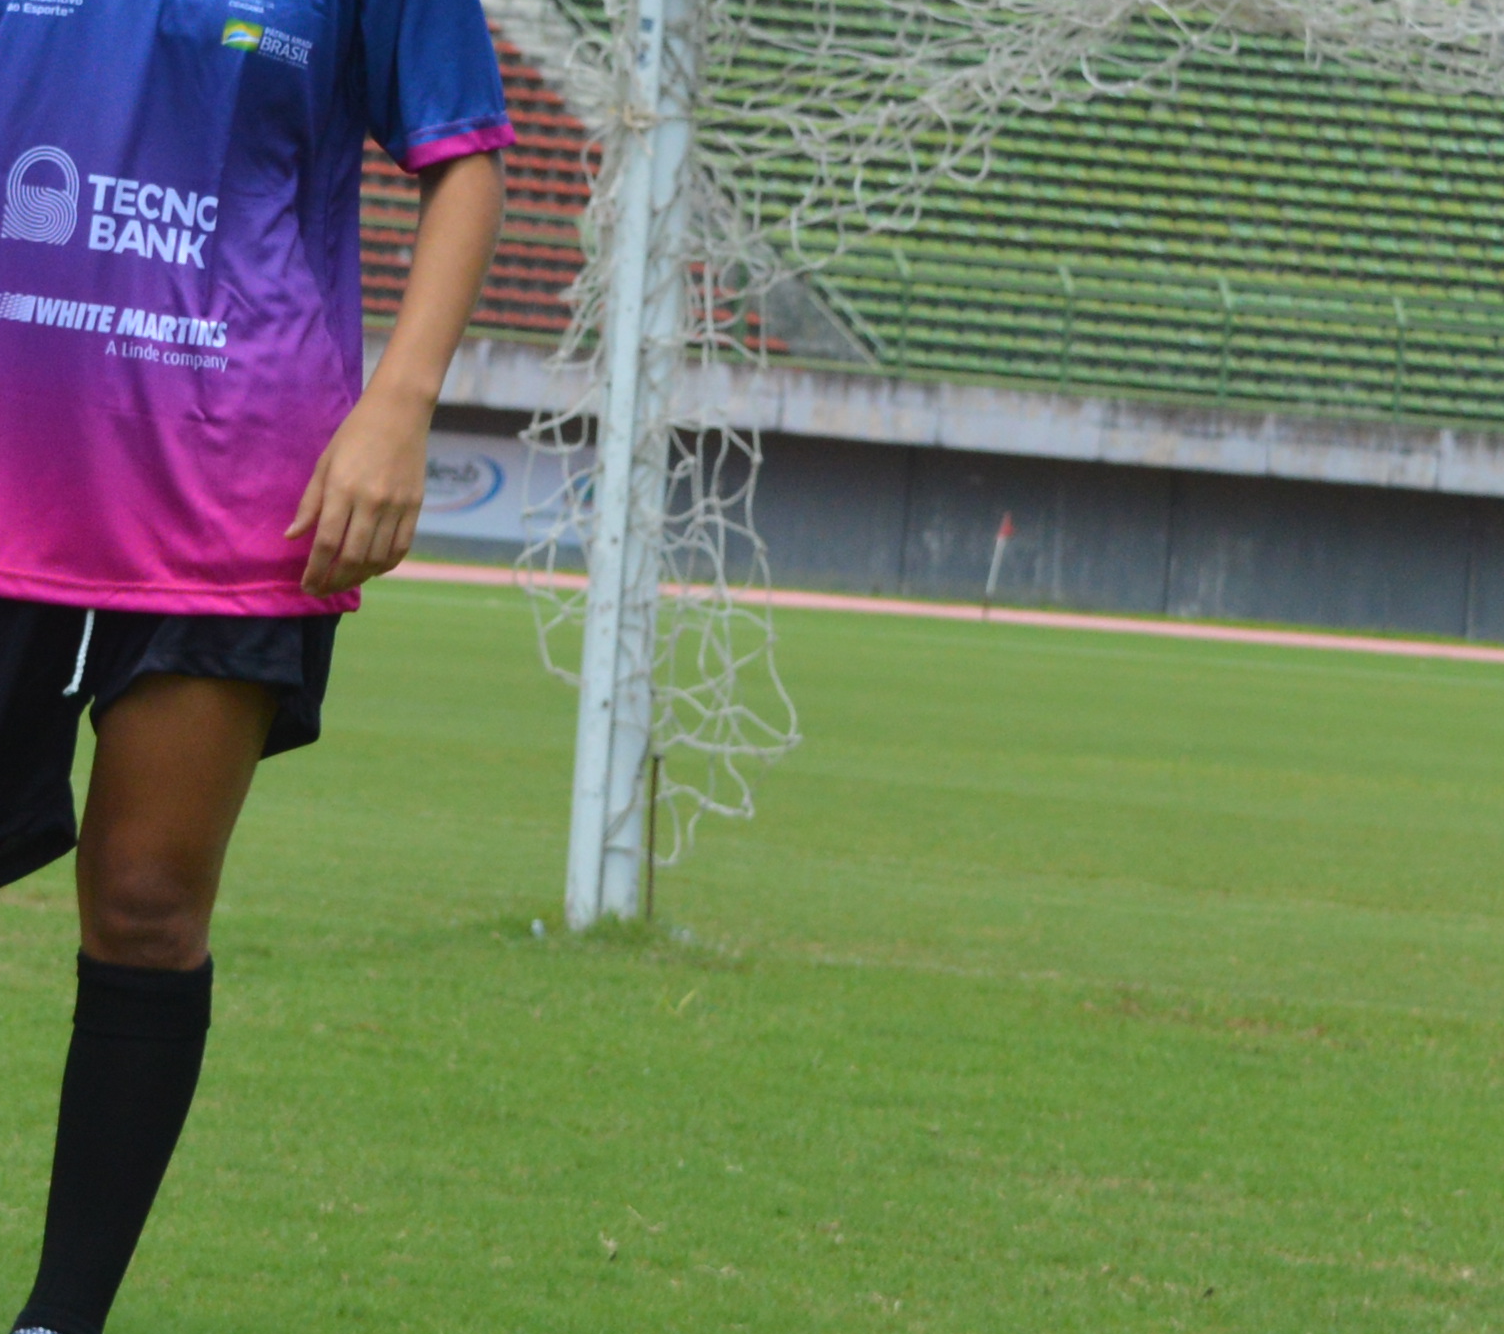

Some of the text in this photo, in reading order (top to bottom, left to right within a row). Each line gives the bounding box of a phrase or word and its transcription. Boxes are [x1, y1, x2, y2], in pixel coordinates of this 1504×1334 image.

[259, 36, 310, 65] BRASIL
[88, 214, 208, 269] BANK
[35, 296, 228, 348] WHITE MARTINS
[105, 340, 229, 372] A Linde company
